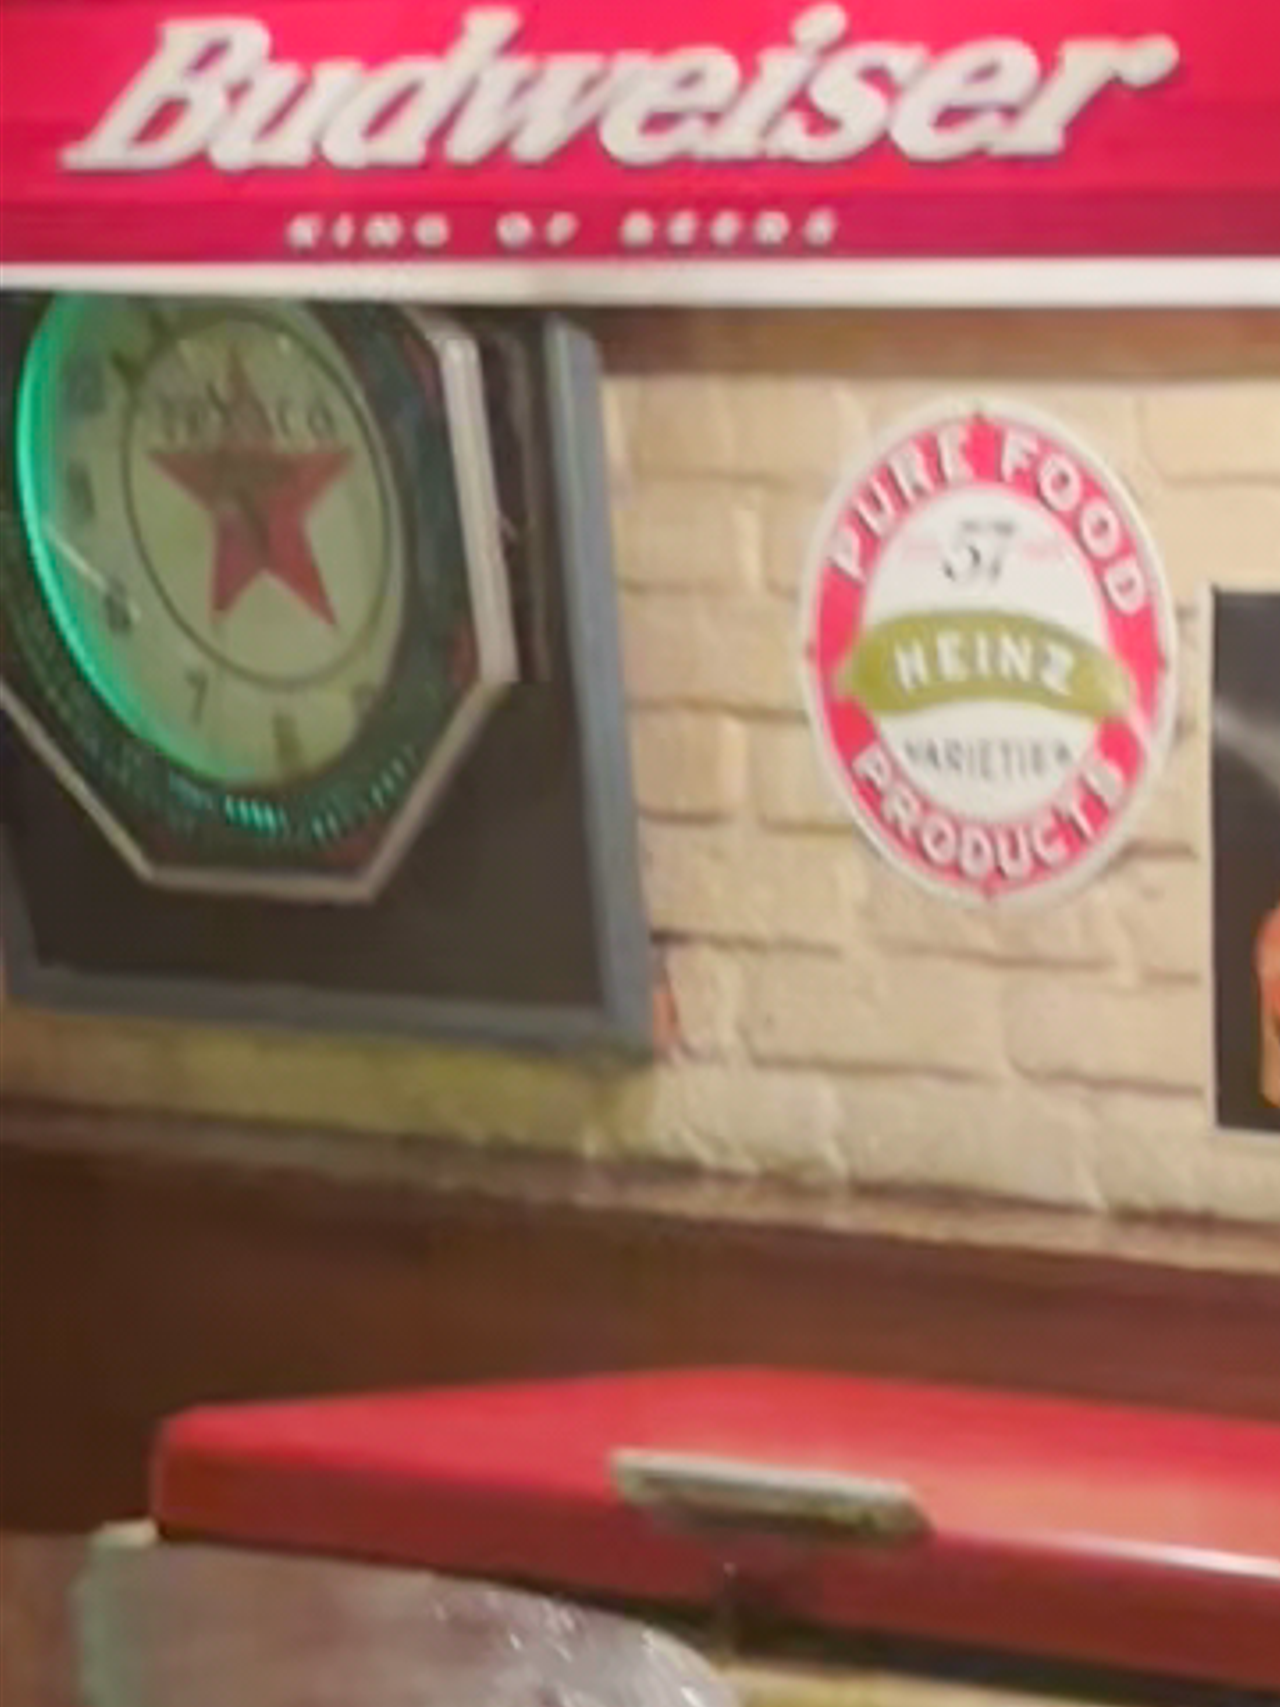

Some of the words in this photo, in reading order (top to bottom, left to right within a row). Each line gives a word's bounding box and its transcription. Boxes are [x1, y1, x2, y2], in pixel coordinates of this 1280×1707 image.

[62, 2, 1181, 173] Budweiser
[830, 424, 975, 583] PURE
[999, 426, 1147, 615] FOOD
[940, 517, 1018, 586] 57
[894, 628, 1076, 696] HEINZ
[852, 743, 1124, 882] PRODUCTS
